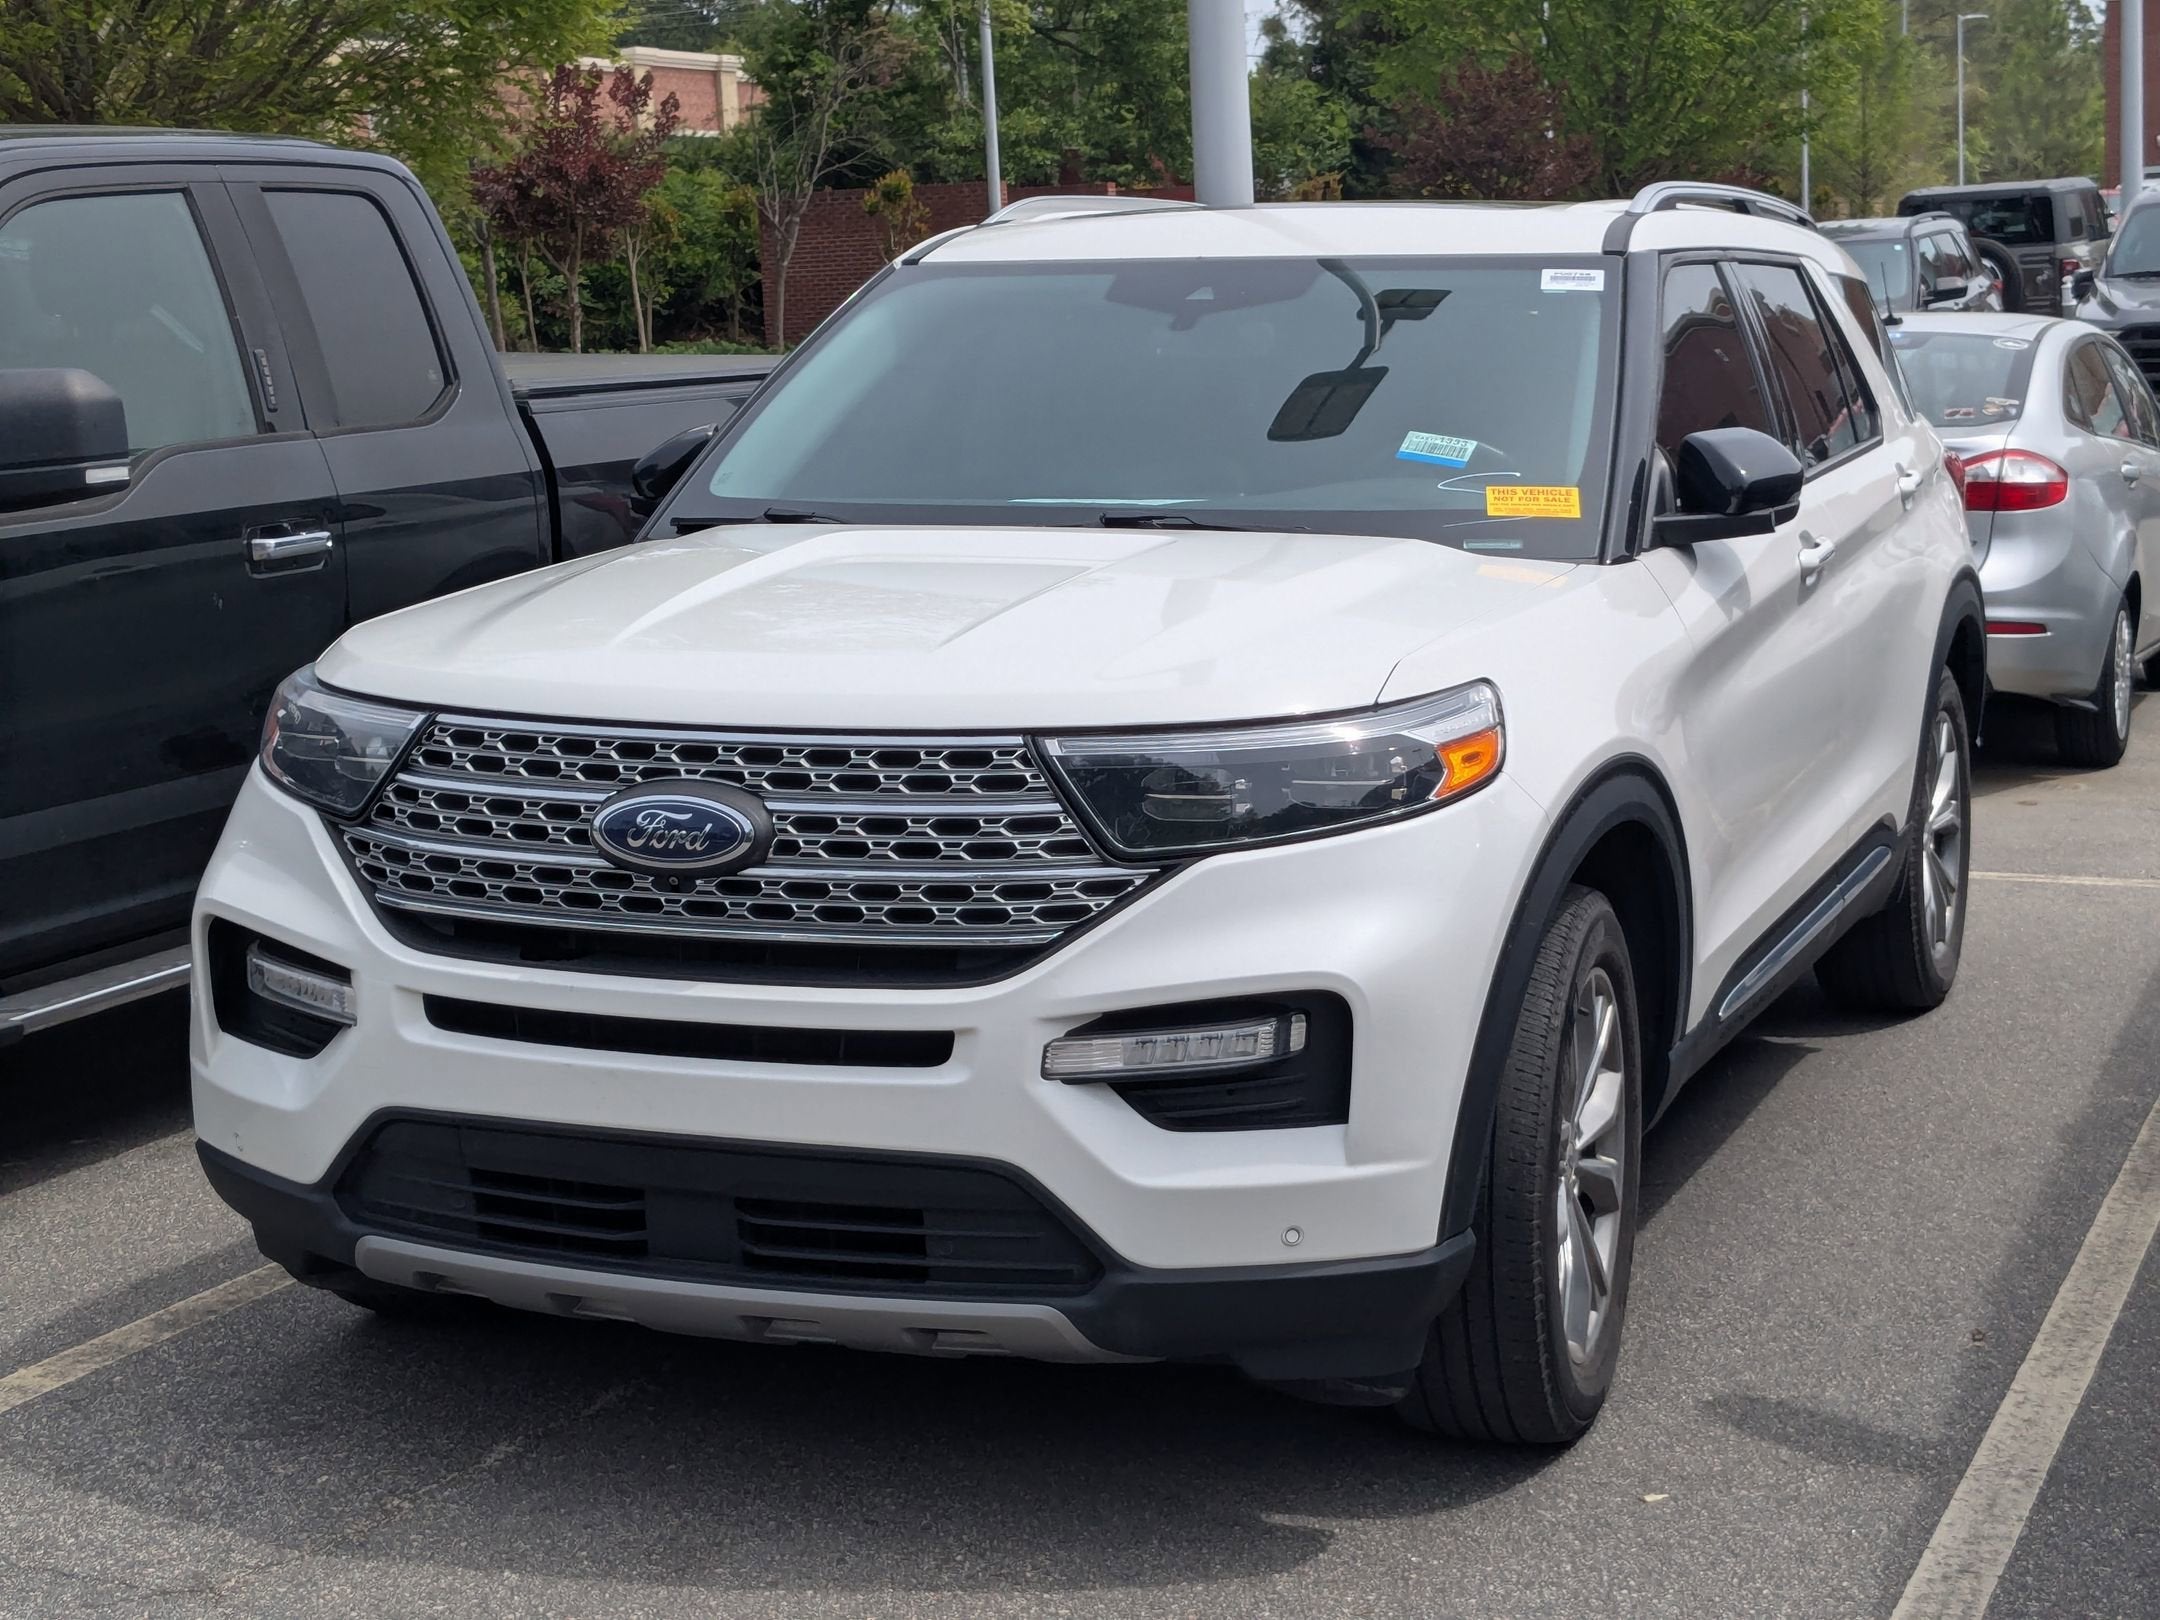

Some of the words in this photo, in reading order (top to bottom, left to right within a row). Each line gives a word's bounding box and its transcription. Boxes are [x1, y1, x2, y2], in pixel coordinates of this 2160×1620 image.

[1491, 488, 1518, 496] THIS
[1521, 488, 1573, 497] VEHICLE
[626, 809, 713, 851] Ford
